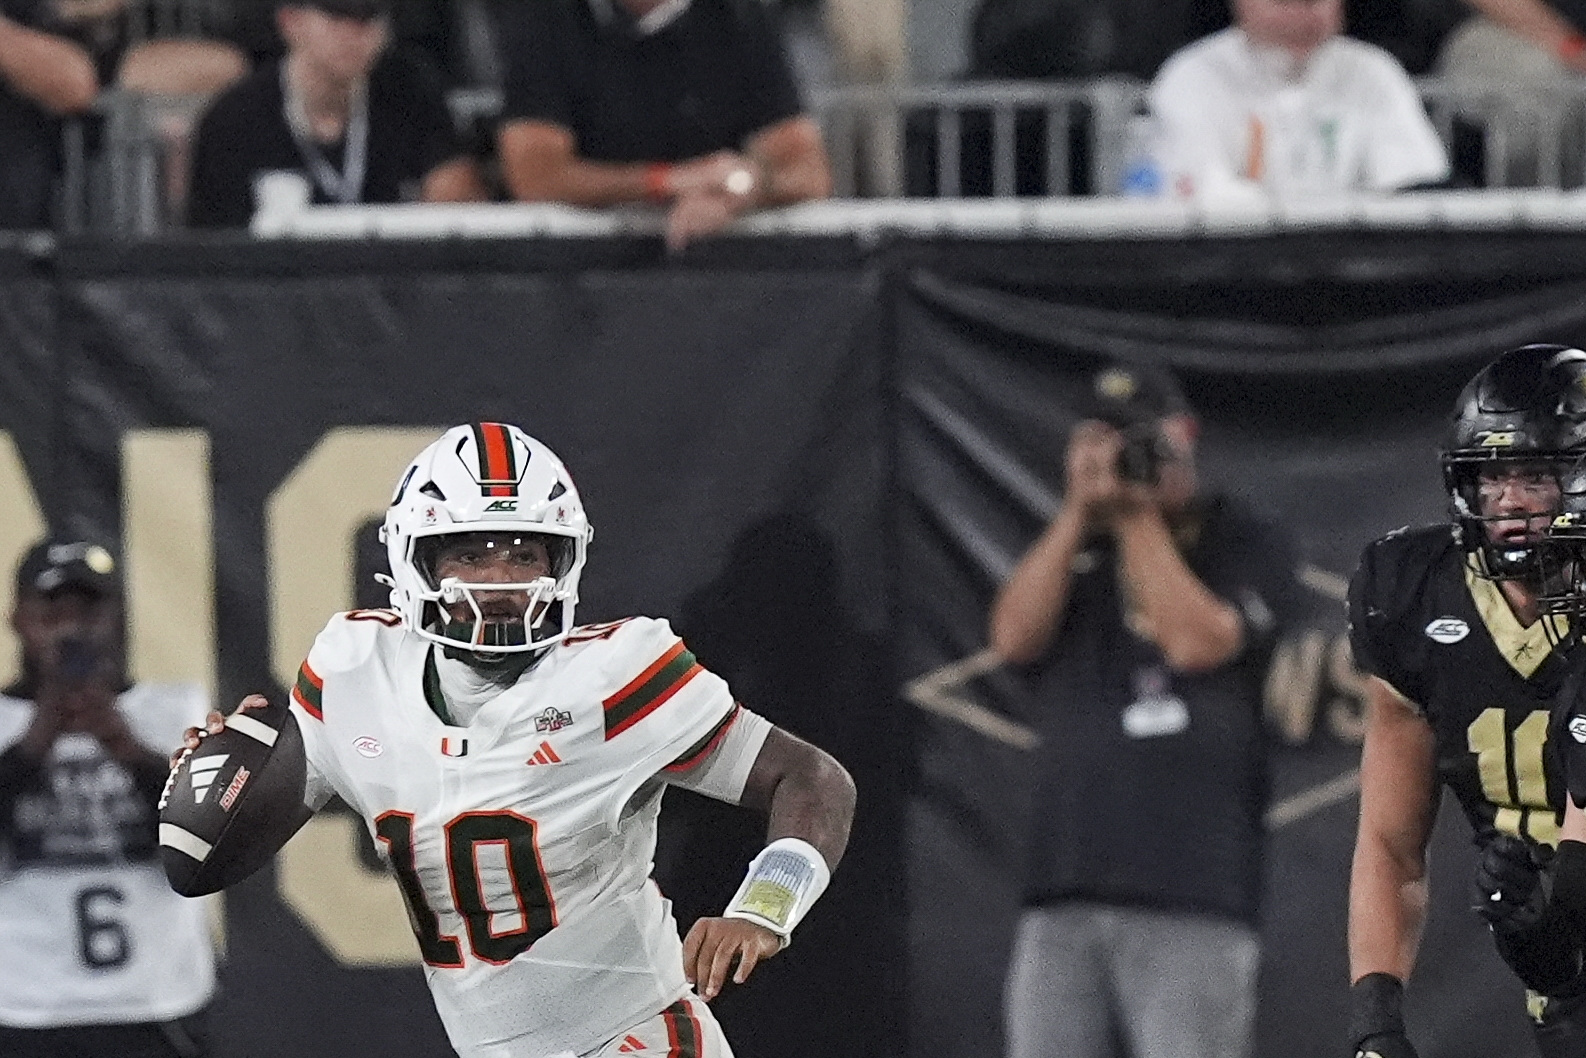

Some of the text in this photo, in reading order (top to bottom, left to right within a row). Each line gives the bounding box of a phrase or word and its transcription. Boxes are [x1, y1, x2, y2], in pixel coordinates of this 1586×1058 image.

[483, 500, 518, 512] ACC
[356, 741, 382, 753] ACC
[441, 737, 468, 758] U
[218, 765, 251, 813] DIME
[374, 809, 559, 969] 10
[75, 885, 132, 971] 6
